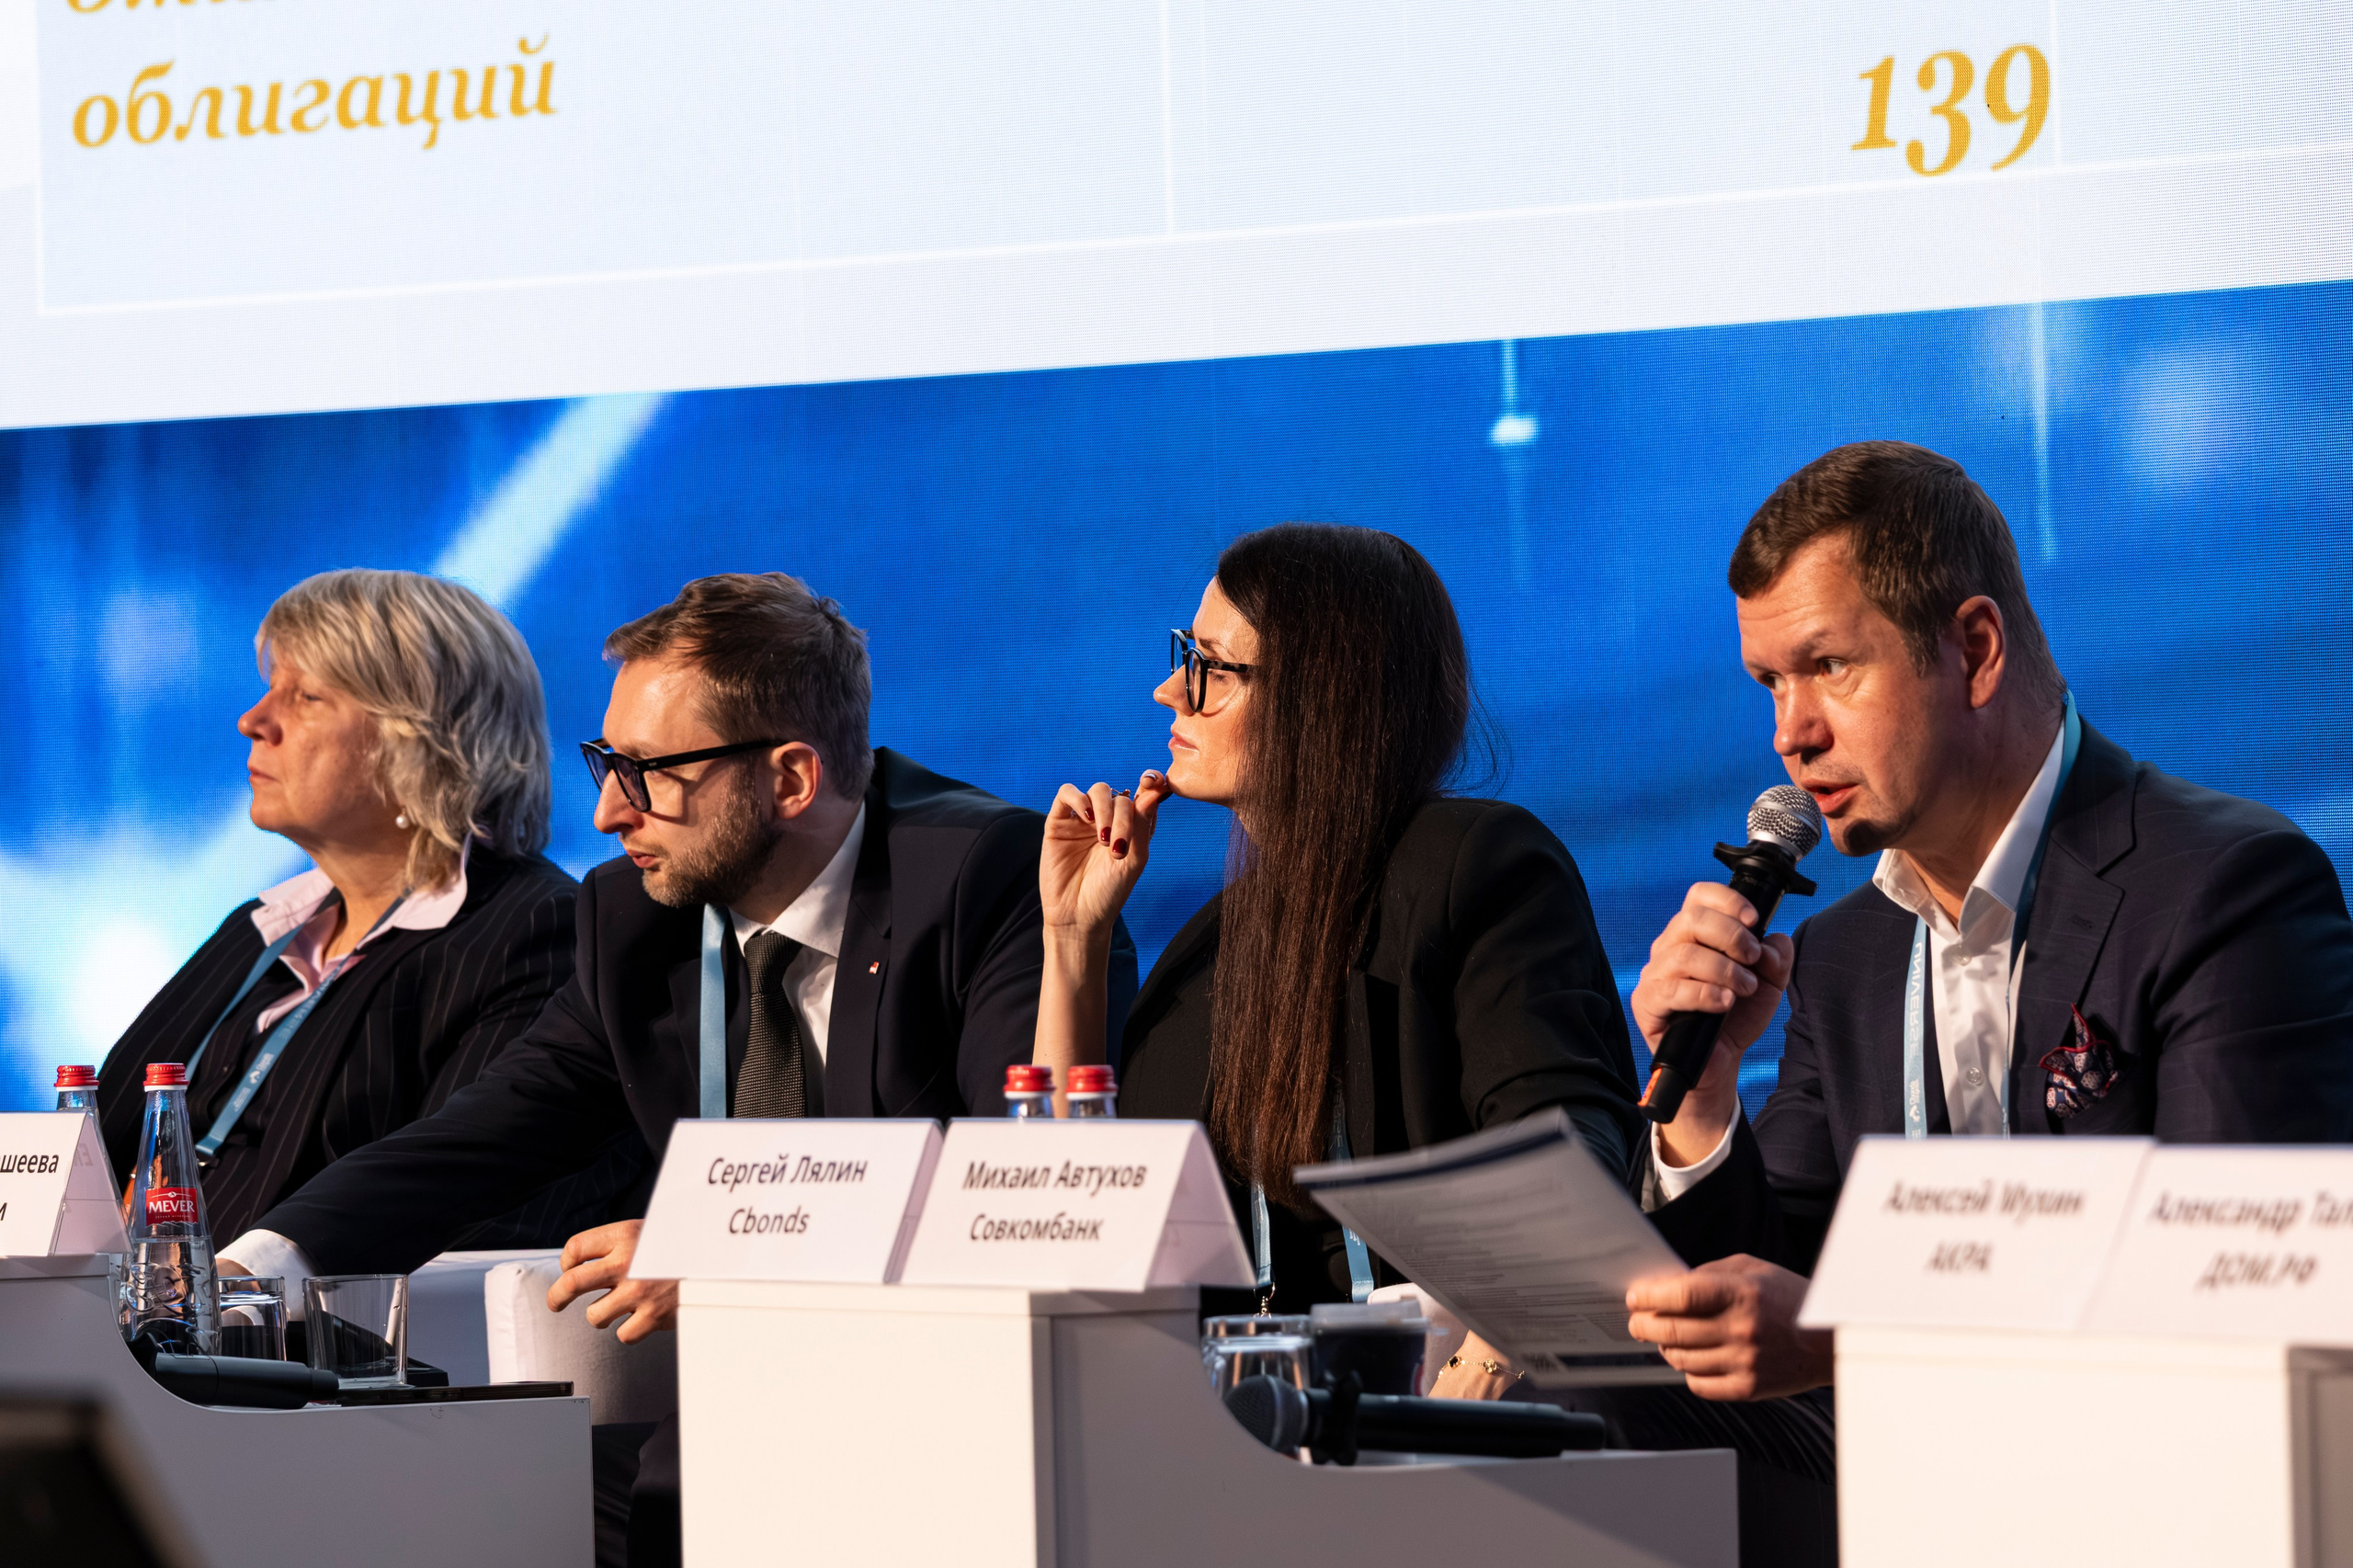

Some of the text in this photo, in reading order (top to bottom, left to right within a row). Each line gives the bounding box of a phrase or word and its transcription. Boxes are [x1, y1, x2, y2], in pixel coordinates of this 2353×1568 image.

[73, 33, 558, 150] облигаций
[1850, 42, 2051, 176] 139
[708, 1153, 868, 1194] Сергей Лялин
[961, 1159, 1148, 1198] Михаил Автухов
[148, 1199, 196, 1213] MEVER
[728, 1205, 811, 1234] Cbonds
[970, 1210, 1104, 1241] Совкомбанк
